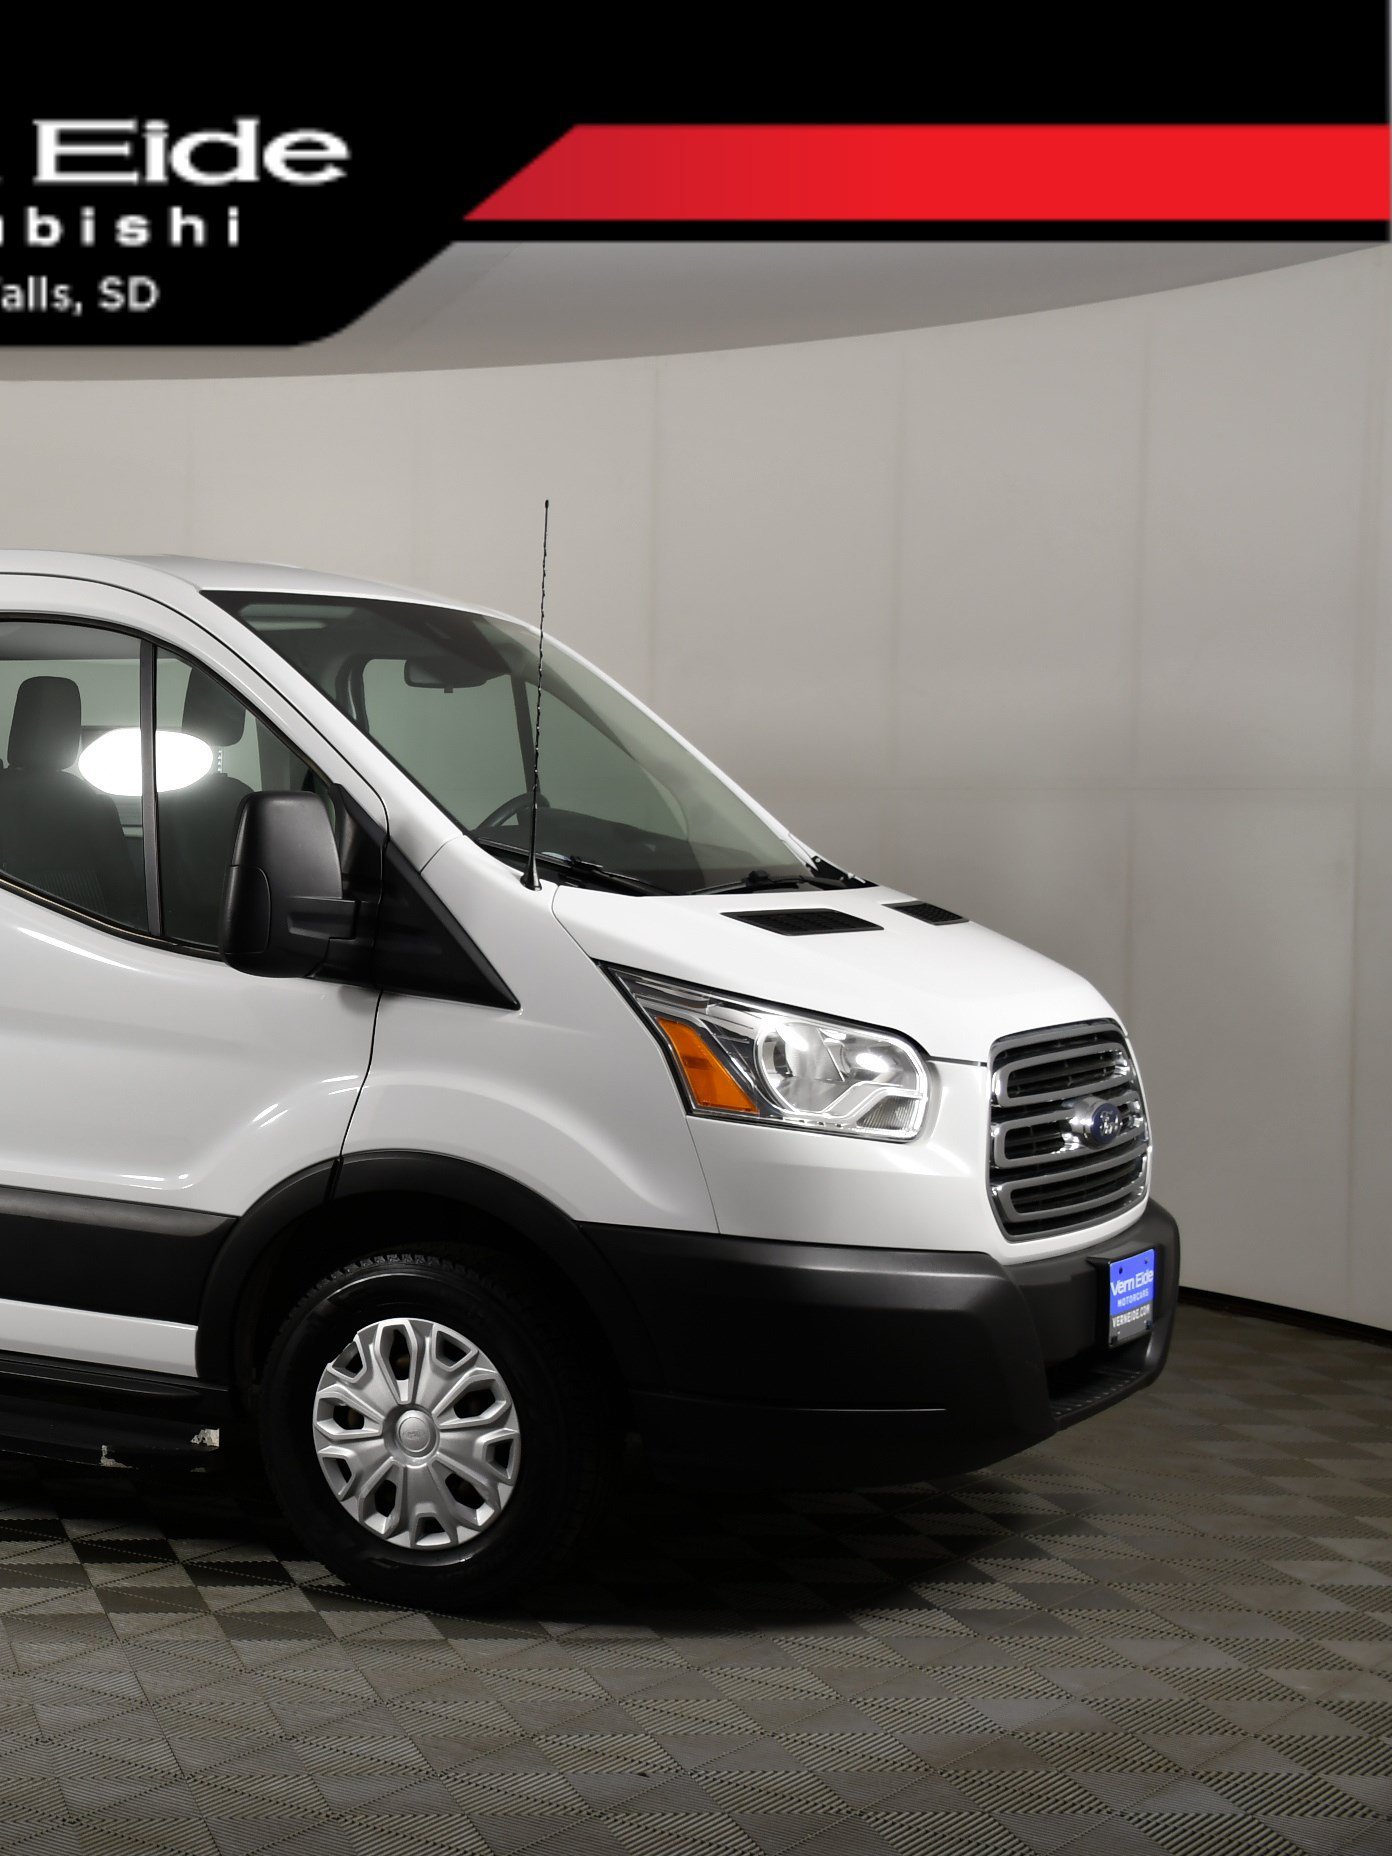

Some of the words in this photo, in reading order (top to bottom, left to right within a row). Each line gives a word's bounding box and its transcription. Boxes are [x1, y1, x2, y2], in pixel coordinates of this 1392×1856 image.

[1110, 1279, 1135, 1296] Vern
[1135, 1269, 1154, 1288] Eide
[1117, 1288, 1149, 1307] MOTORCARS
